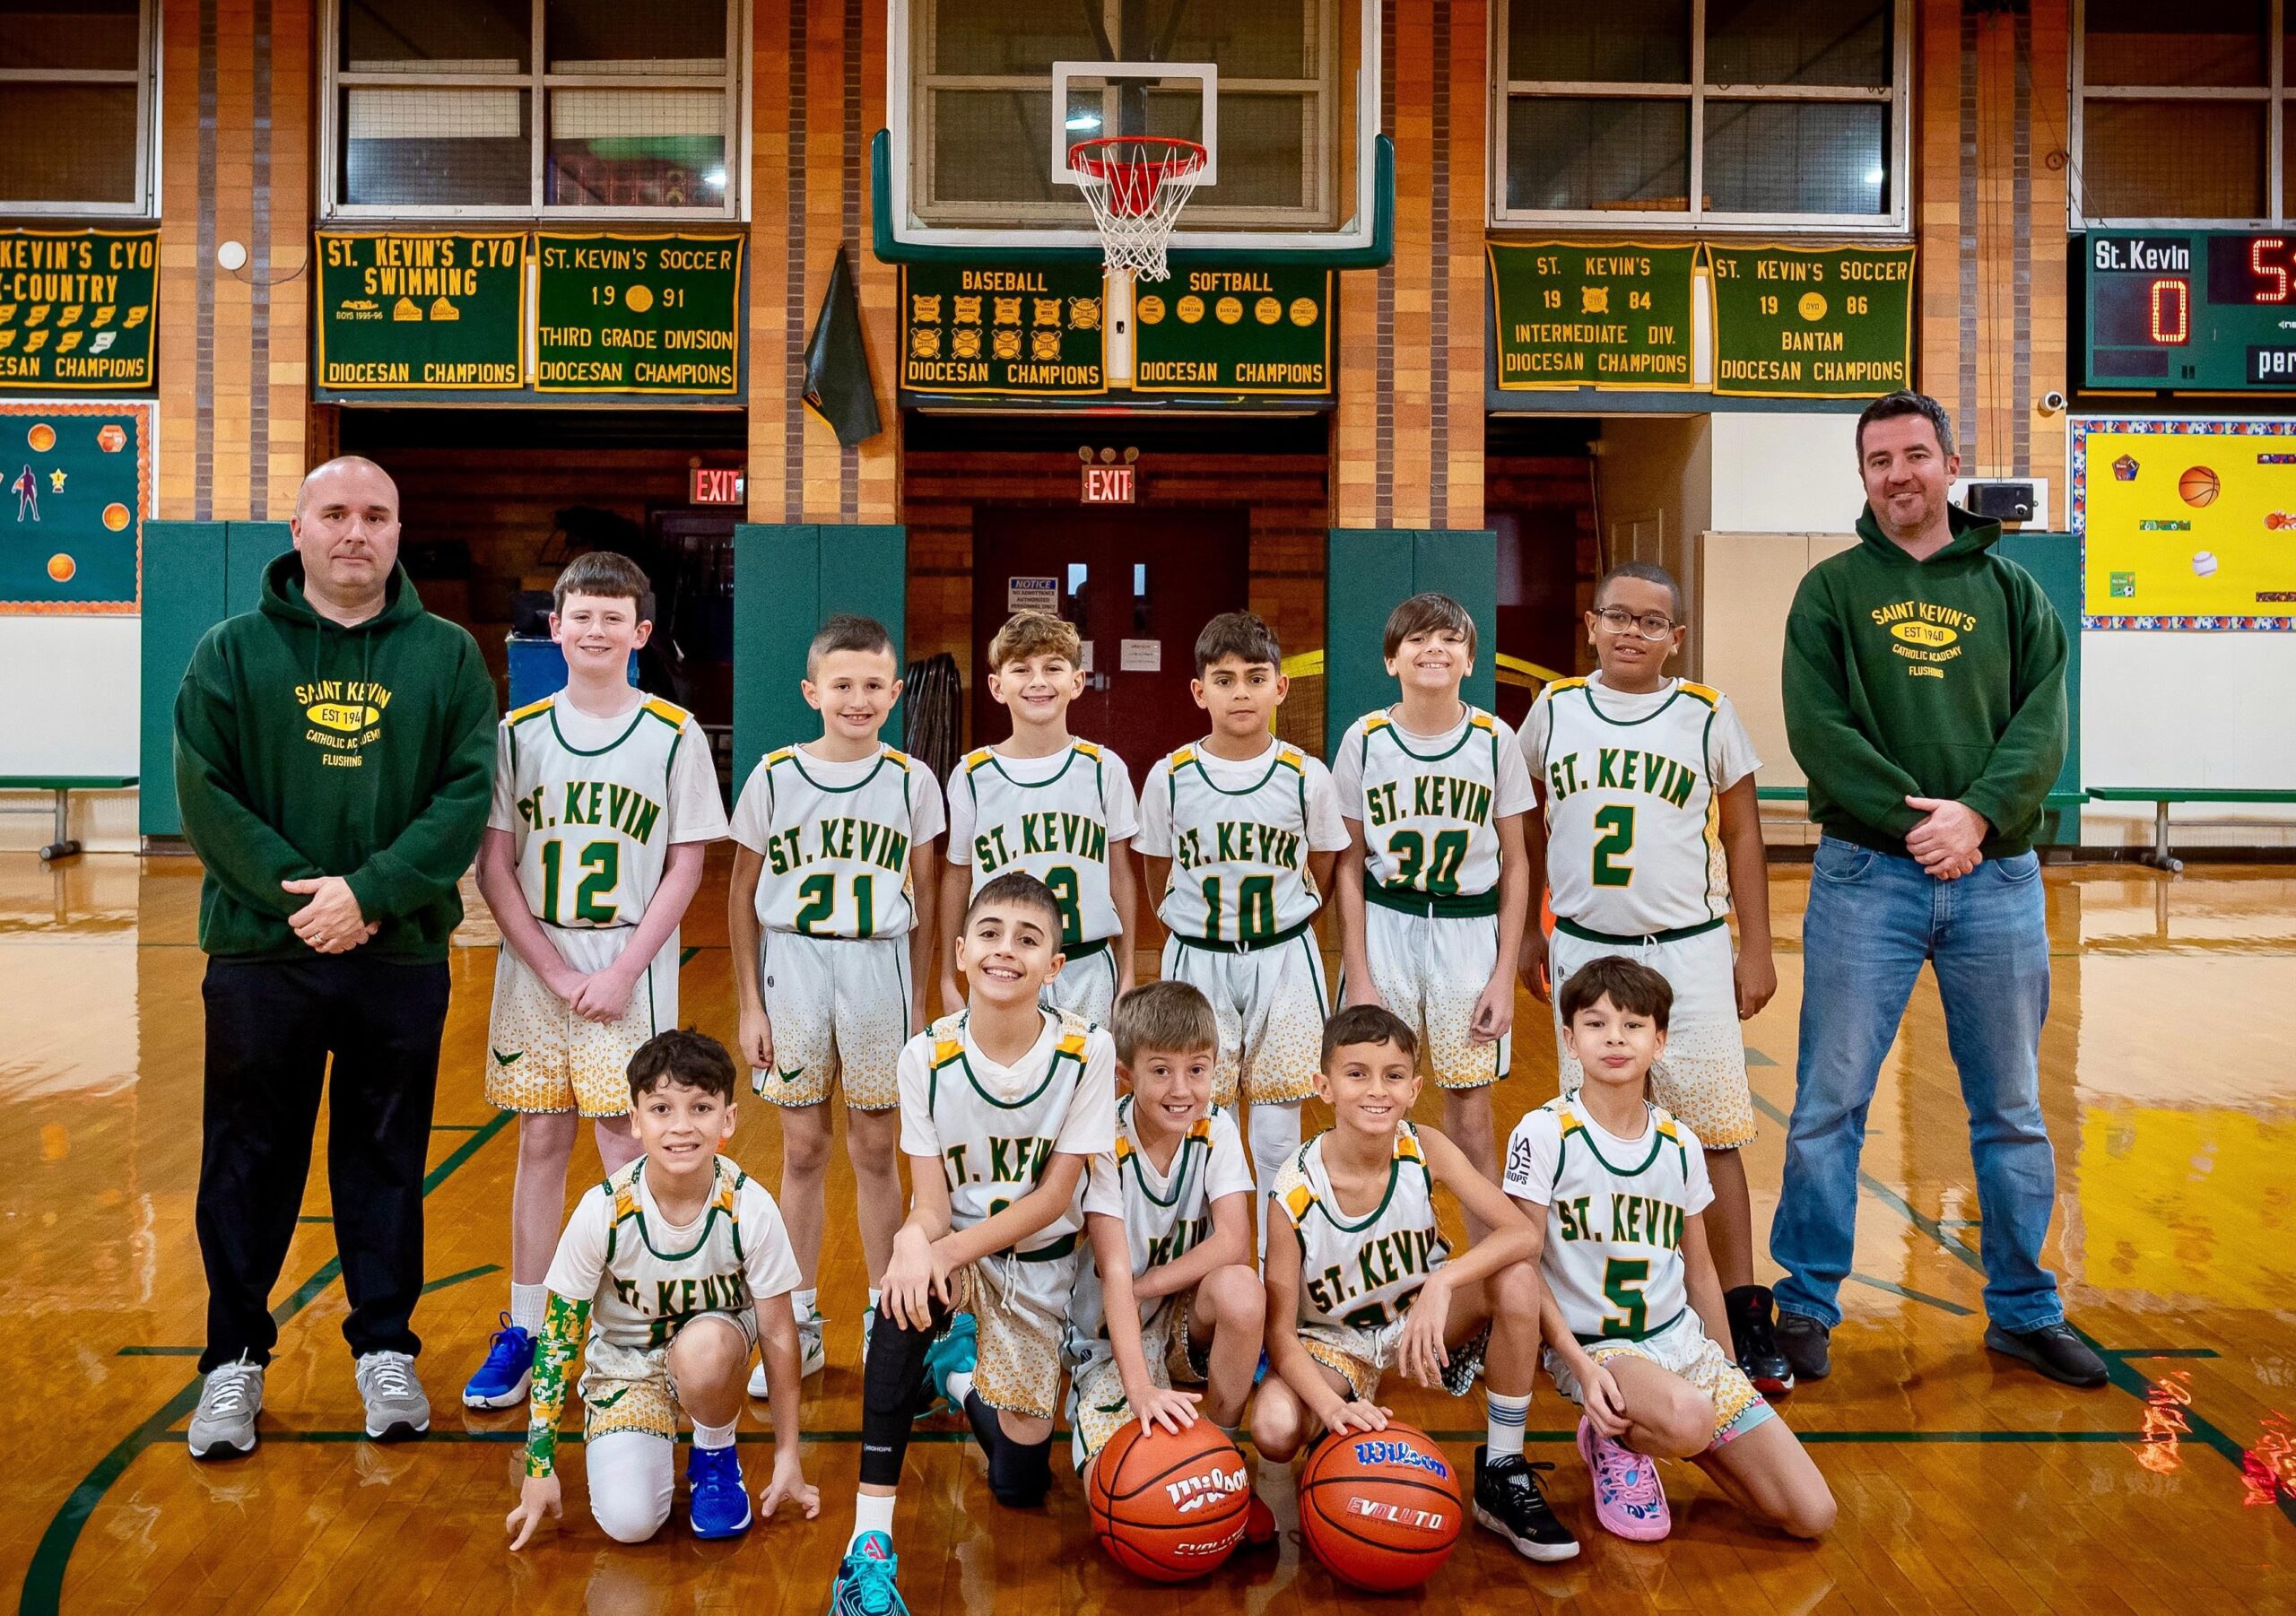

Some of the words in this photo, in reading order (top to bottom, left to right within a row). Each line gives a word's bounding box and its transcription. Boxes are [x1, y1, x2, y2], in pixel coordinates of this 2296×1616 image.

[0, 239, 92, 269] KEVIN'S
[109, 240, 153, 269] CYO
[327, 239, 358, 266] ST.
[375, 239, 455, 267] KEVIN'S
[471, 239, 516, 267] CYO
[544, 248, 570, 269] ST.
[575, 248, 648, 270] KEVIN'S
[659, 248, 732, 271] SOCCER
[1536, 256, 1561, 275] ST.
[1586, 257, 1651, 276] KEVIN'S
[1716, 258, 1741, 278] ST.
[1757, 260, 1823, 282] KEVIN'S
[1839, 261, 1907, 281] SOCCER
[364, 267, 477, 296] SWIMMING
[962, 271, 1048, 292] BASEBALL
[1189, 272, 1274, 292] SOFTBALL
[592, 285, 615, 306] 19
[662, 288, 684, 308] 91
[1543, 290, 1561, 308] 19
[1629, 291, 1651, 310] 84
[1760, 295, 1779, 315] 19
[1846, 295, 1868, 315] 86
[336, 311, 354, 320] BOYS
[356, 311, 383, 320] 1995-96
[2152, 280, 2187, 343] 0
[539, 326, 592, 347] THIRD
[601, 328, 657, 349] GRADE
[665, 329, 733, 351] DIVISION
[1515, 324, 1629, 343] INTERMEDIATE
[1648, 326, 1676, 345] DIV.
[1781, 331, 1843, 351] BANTAM
[56, 358, 144, 378] CHAMPIONS
[329, 363, 409, 382] DIOCESAN
[423, 363, 516, 383] CHAMPIONS
[539, 361, 622, 381] DIOCESAN
[634, 362, 733, 385] CHAMPIONS
[909, 361, 989, 382] DIOCESAN
[1007, 364, 1100, 385] CHAMPIONS
[1140, 361, 1218, 382] DIOCESAN
[1235, 363, 1323, 383] CHAMPIONS
[1506, 352, 1584, 372] DIOCESAN
[1597, 353, 1687, 373] CHAMPIONS
[1720, 360, 1802, 380] DIOCESAN
[1813, 361, 1903, 381] CHAMPIONS
[696, 470, 739, 502] EXIT
[1088, 469, 1132, 501] EXIT
[1015, 579, 1051, 589] NOTICE
[1871, 601, 1915, 625] SAINT
[1918, 602, 1977, 631] KEVIN'S
[1904, 626, 1921, 638] EST
[1924, 629, 1944, 642] 1940
[1892, 643, 1927, 661] CATHOLIC
[1929, 646, 1962, 662] ACADEMY
[1909, 665, 1944, 679] FLUSHING
[294, 680, 342, 705] SAINT
[346, 682, 392, 709] KEVIN
[322, 708, 341, 723] EST
[343, 712, 361, 725] 194
[306, 729, 345, 749] CATHOLIC
[346, 727, 381, 750] ACDEMY
[322, 754, 362, 768] FLUSHING
[1550, 752, 1588, 802] ST.
[1597, 748, 1698, 810] KEVIN
[562, 781, 662, 847] KEVIN
[1365, 780, 1407, 827] ST.
[1413, 775, 1492, 829] KEVIN
[768, 824, 814, 876] ST.
[819, 817, 909, 874] KEVIN
[974, 822, 1018, 874] ST.
[1021, 811, 1107, 864] KEVIN
[1216, 821, 1300, 872] KEVIN
[1591, 803, 1636, 888] 2
[1384, 828, 1471, 894] 30
[541, 838, 620, 925] 12
[795, 872, 875, 939] 21
[1200, 873, 1278, 942] 10
[944, 1143, 981, 1193] T.
[988, 1135, 1057, 1184] KEV
[1557, 1195, 1603, 1242] ST.
[1307, 1264, 1357, 1314] ST.
[1599, 1256, 1651, 1340] 5
[1353, 1440, 1448, 1481] Wilson
